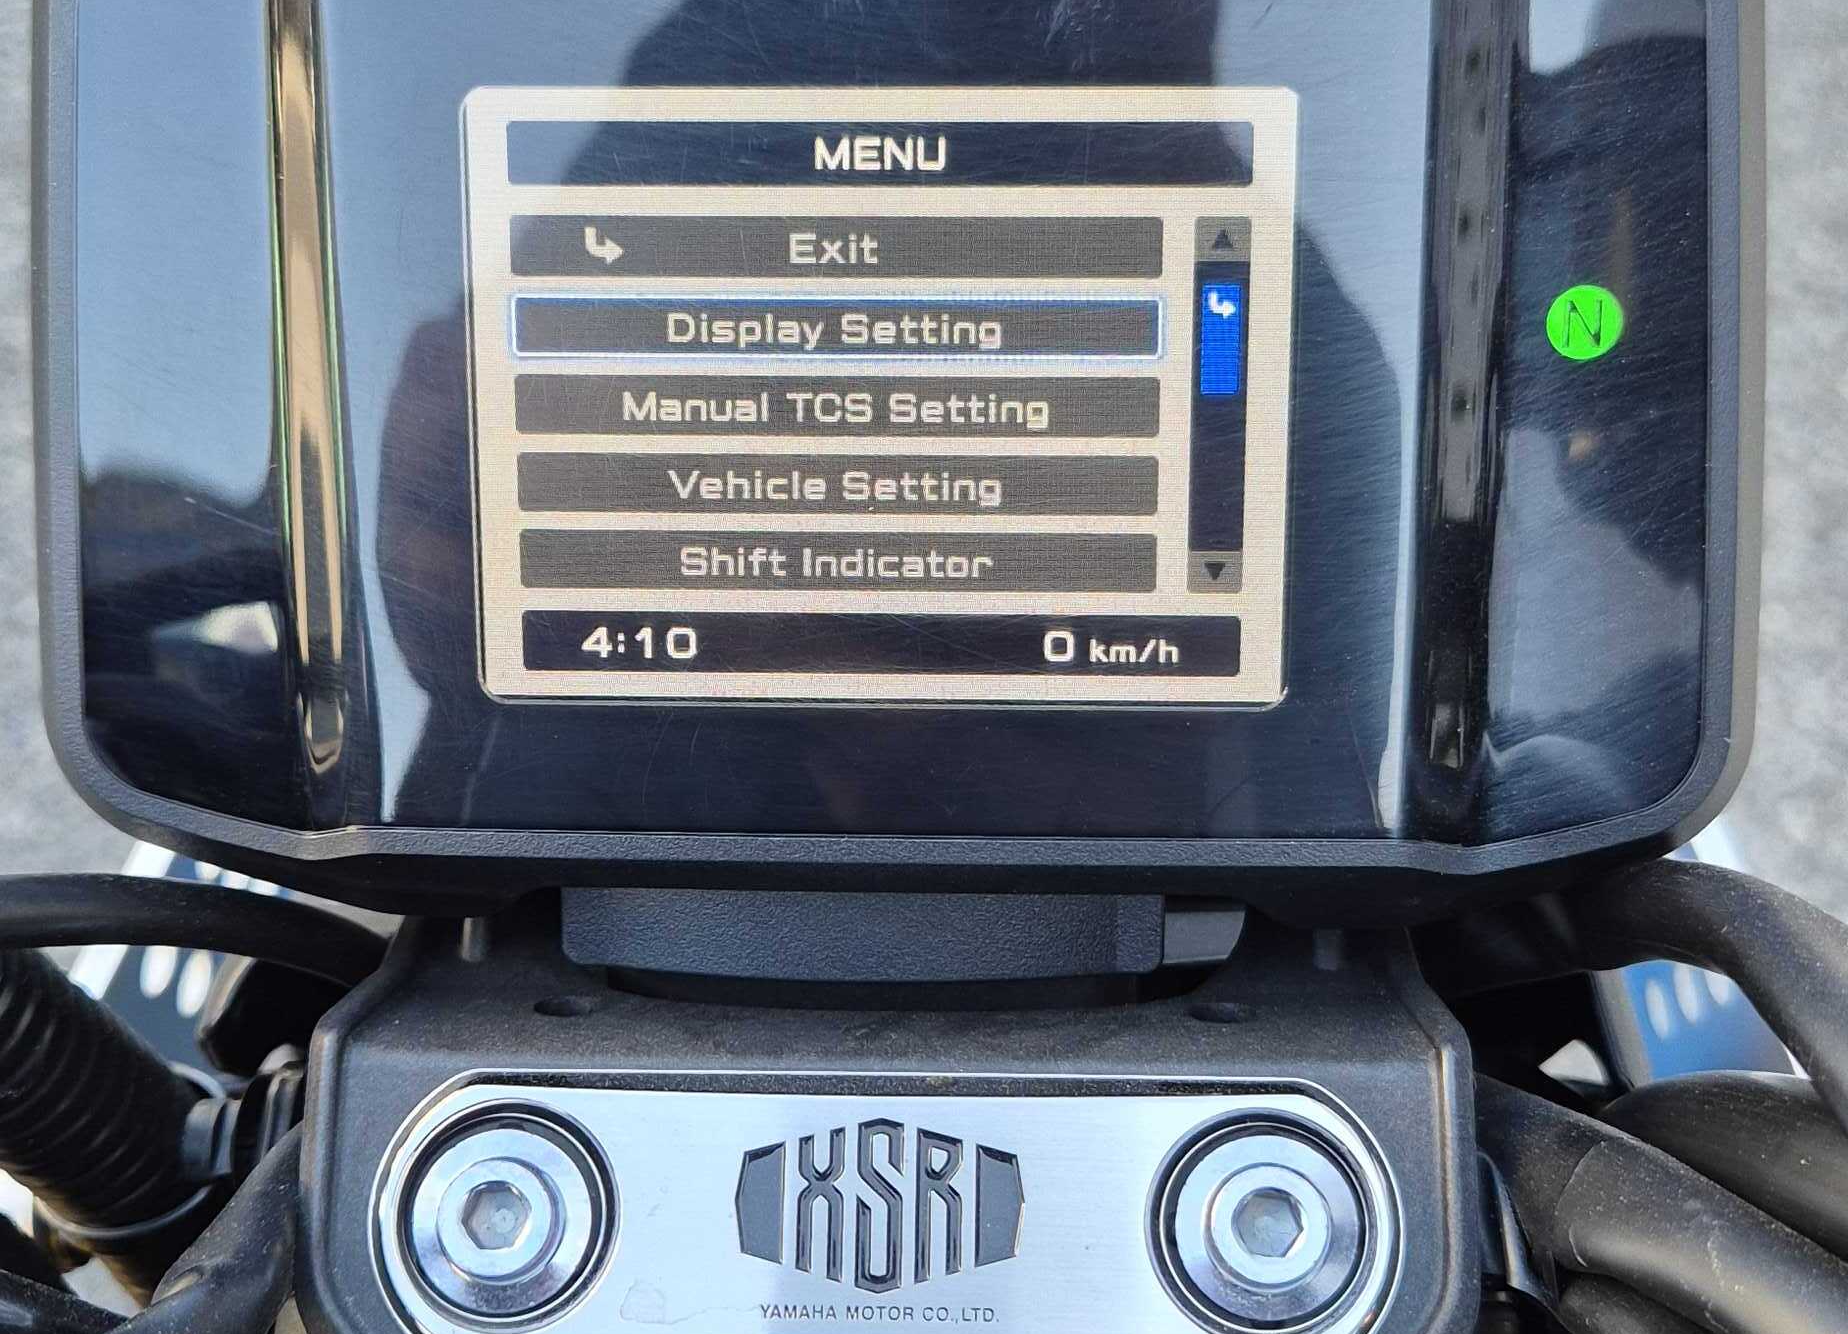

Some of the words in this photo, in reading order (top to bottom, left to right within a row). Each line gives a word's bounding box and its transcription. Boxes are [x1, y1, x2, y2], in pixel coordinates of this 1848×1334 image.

[813, 136, 947, 172] MENU
[788, 233, 879, 266] Exit
[666, 313, 822, 350] Display
[841, 313, 1003, 350] Setting
[1561, 299, 1604, 348] N
[622, 392, 769, 423] Manual
[787, 392, 872, 423] TCS
[888, 391, 1050, 429] Setting
[669, 470, 826, 501] Vehicle
[842, 470, 1003, 507] Setting
[679, 548, 786, 578] Shift
[802, 548, 993, 579] Indicator
[581, 626, 698, 660] 4:10
[1043, 630, 1074, 663] 0
[1089, 638, 1180, 665] km/h
[795, 1118, 963, 1293] XSR
[759, 1304, 837, 1322] YAMAHA
[845, 1304, 915, 1322] MOTOR
